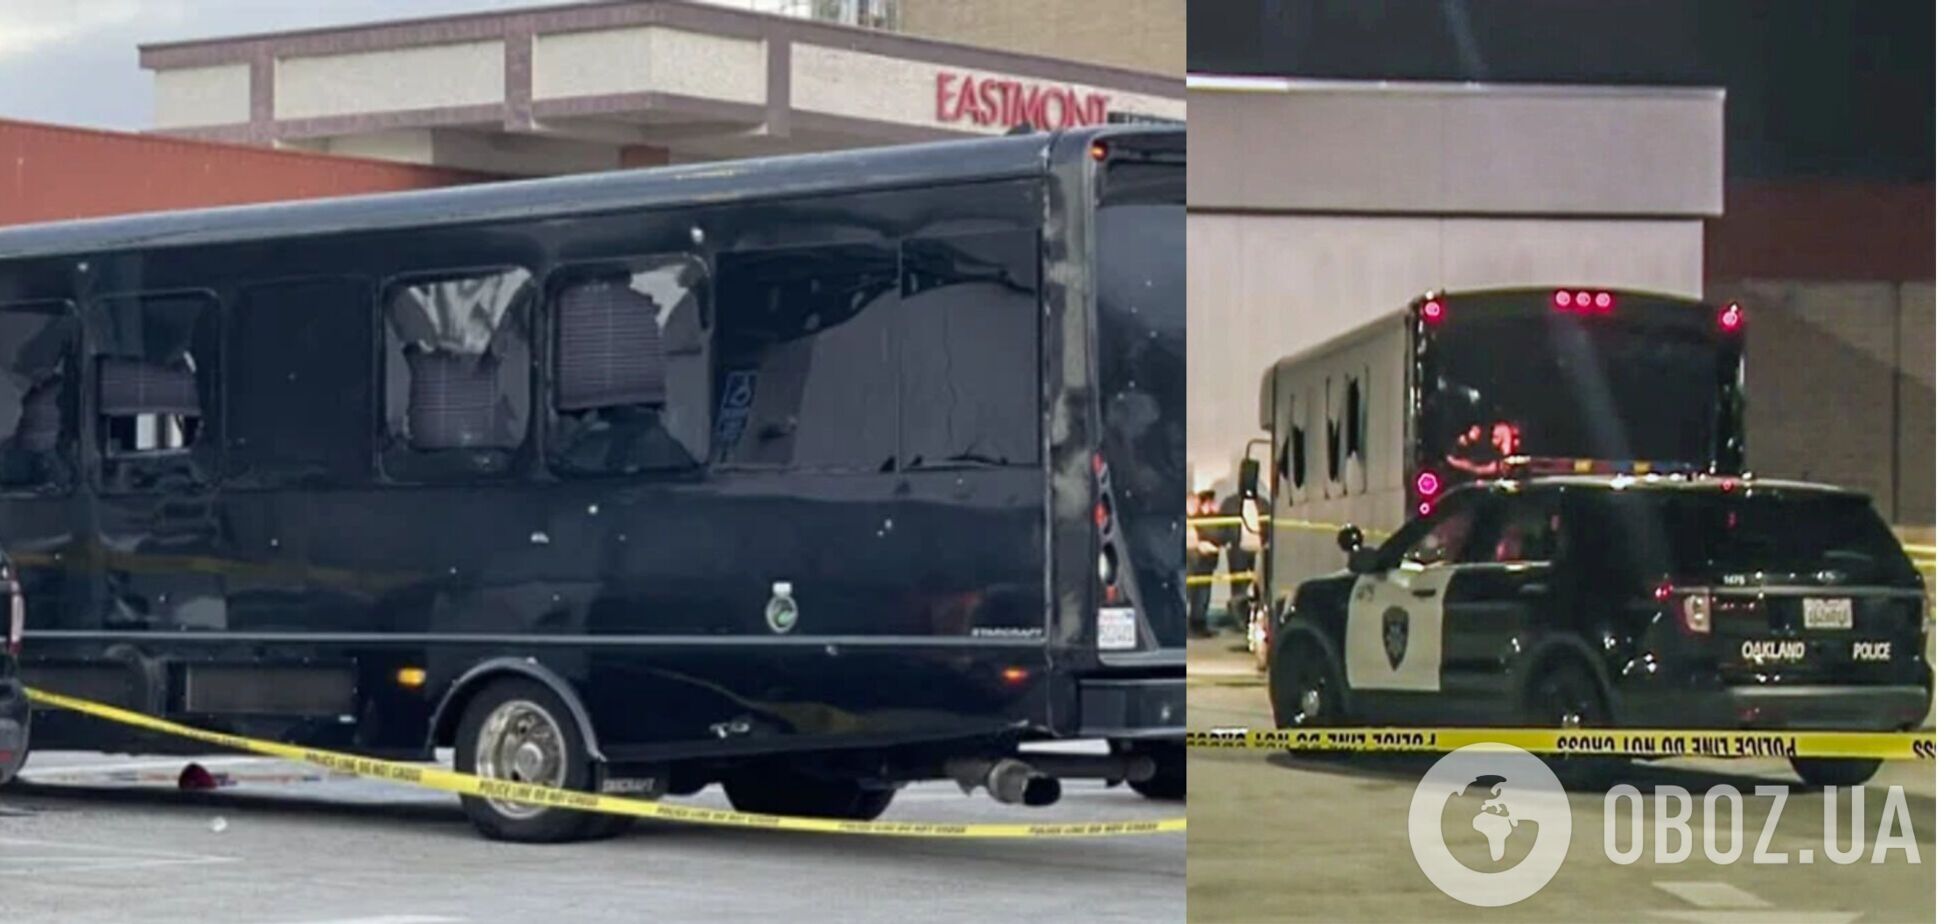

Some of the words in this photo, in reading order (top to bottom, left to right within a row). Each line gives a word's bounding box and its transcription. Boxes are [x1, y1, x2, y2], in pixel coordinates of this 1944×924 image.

[936, 72, 1109, 131] EASTMONT
[1742, 641, 1805, 660] OAKLAND
[1853, 642, 1891, 660] POLICE
[1735, 736, 1797, 756] POLICE
